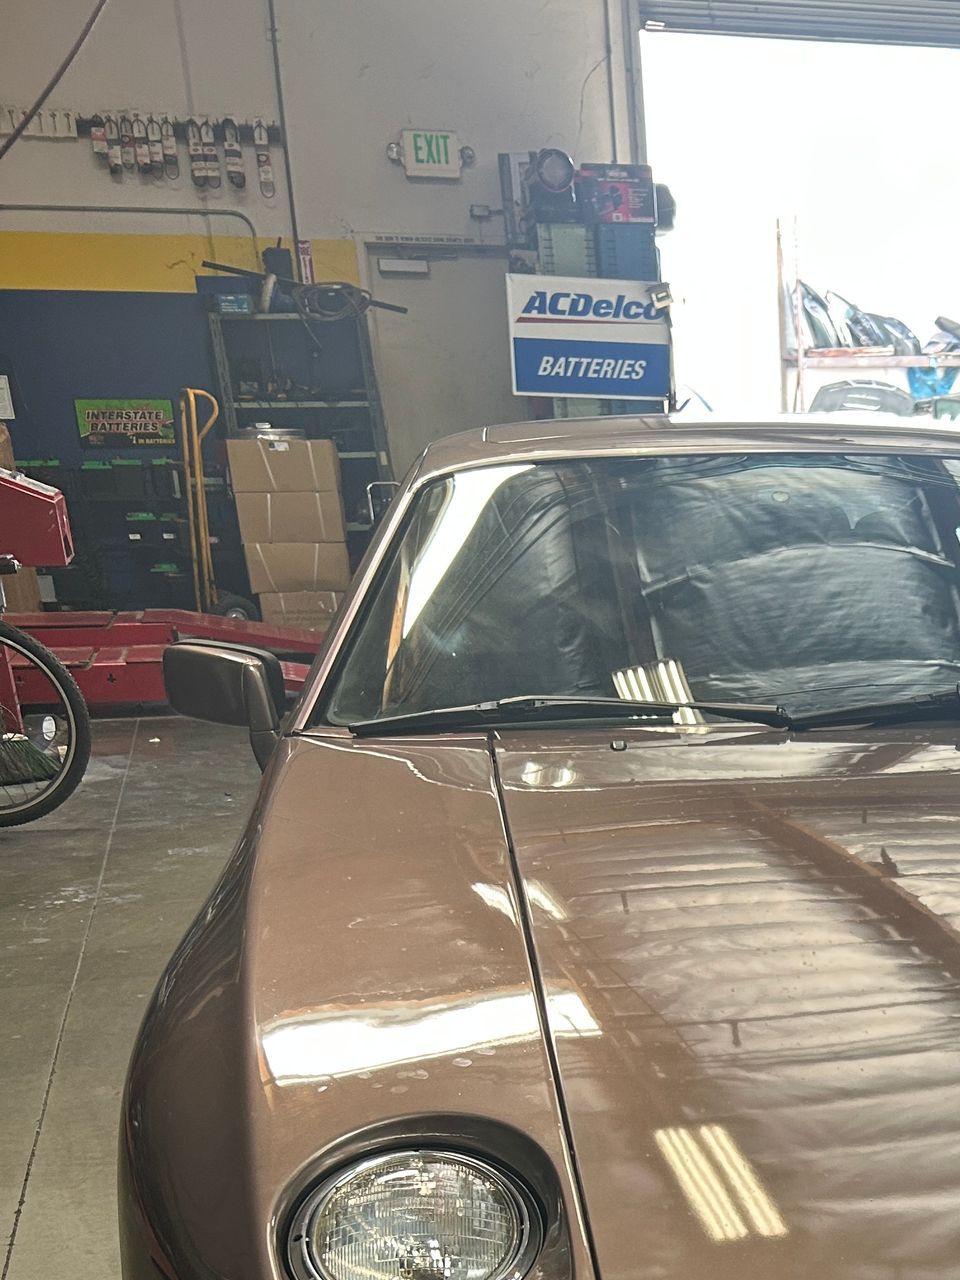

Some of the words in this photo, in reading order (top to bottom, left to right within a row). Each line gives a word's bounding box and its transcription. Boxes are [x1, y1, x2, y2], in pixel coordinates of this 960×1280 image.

[413, 133, 449, 164] EXIT
[522, 291, 665, 320] ACDelco
[537, 356, 647, 380] BATTERIES
[86, 410, 162, 421] INTERSTATE
[90, 422, 159, 432] BATTERIES
